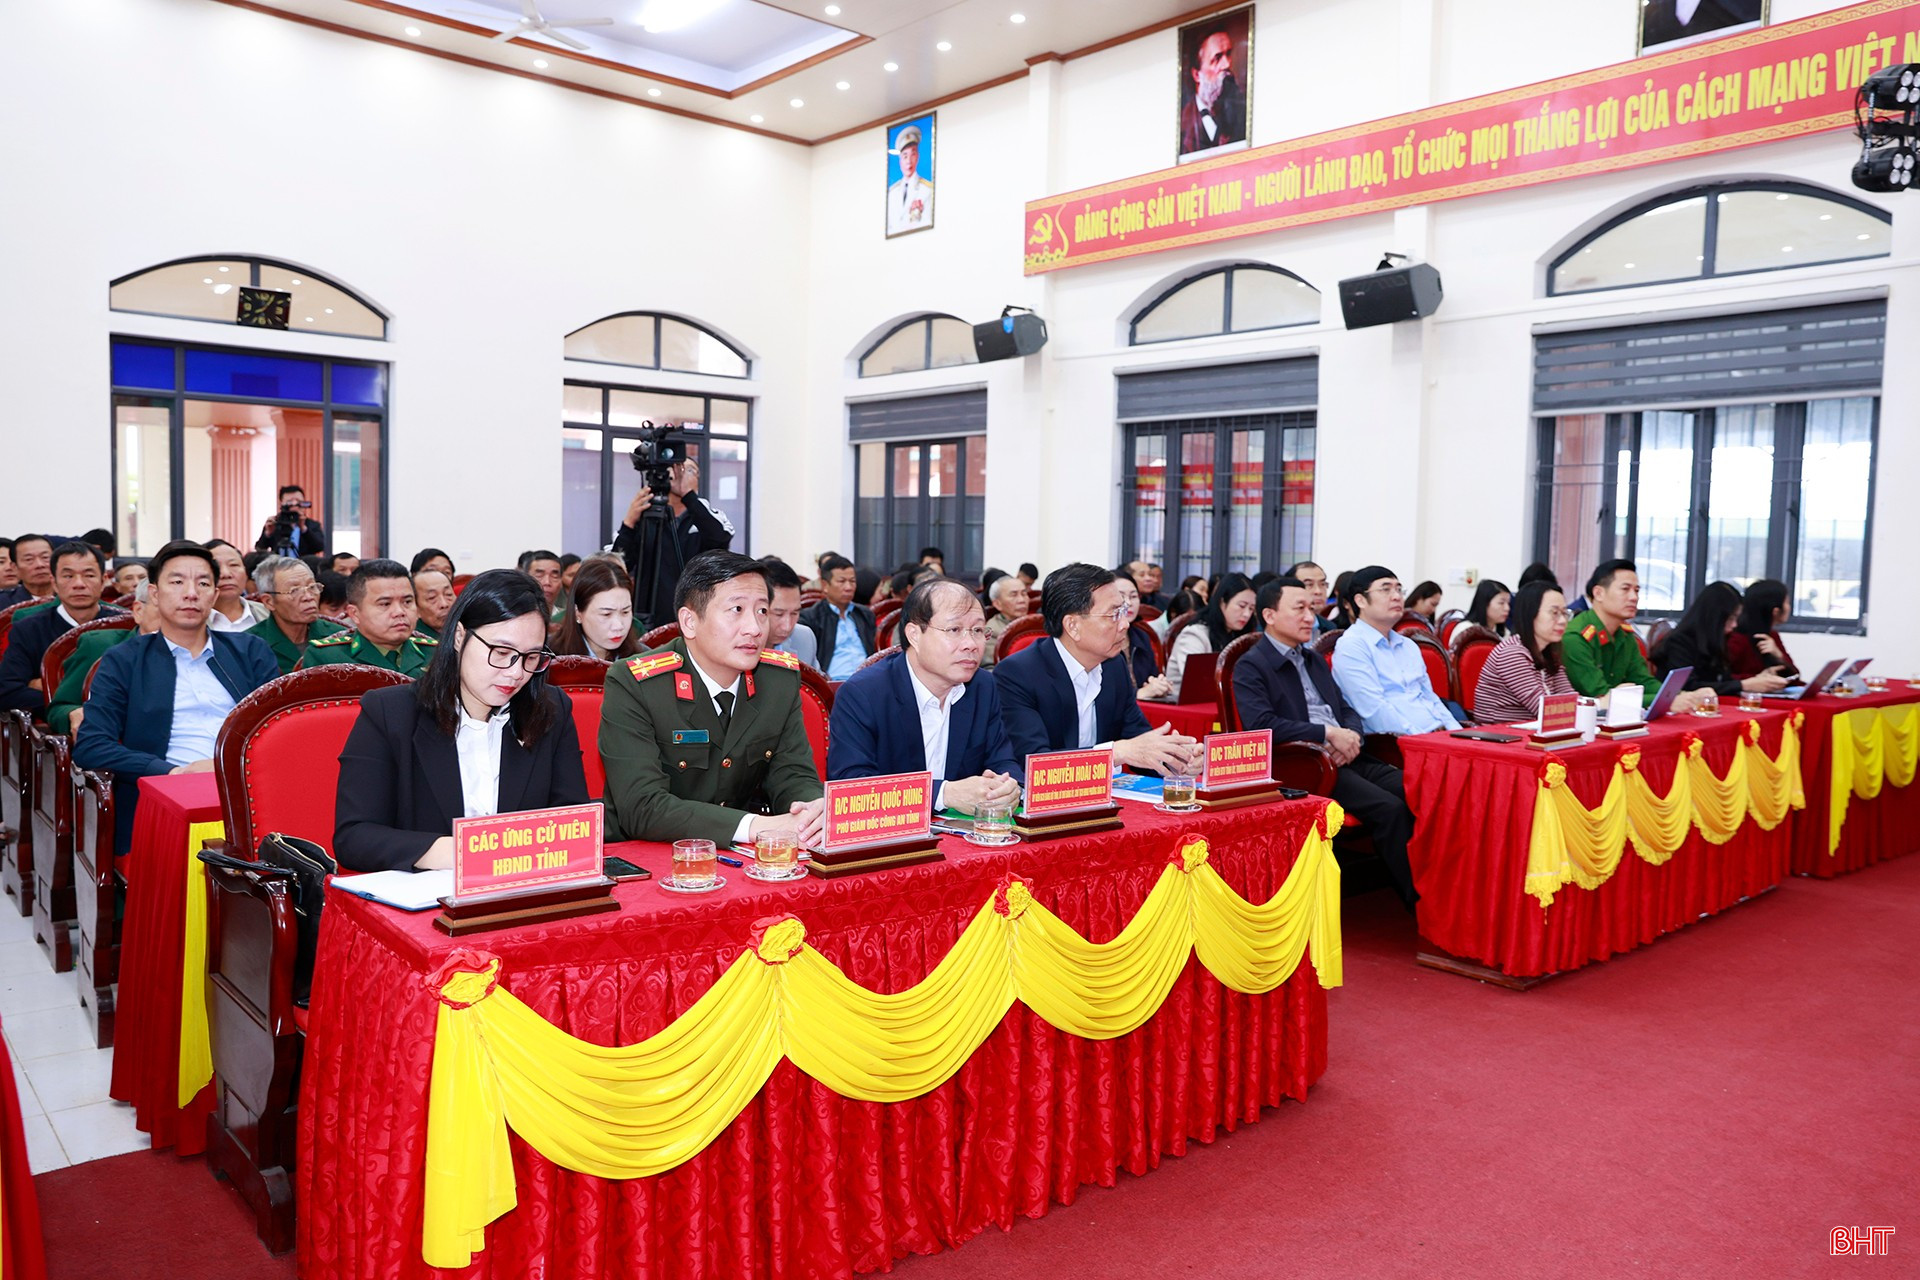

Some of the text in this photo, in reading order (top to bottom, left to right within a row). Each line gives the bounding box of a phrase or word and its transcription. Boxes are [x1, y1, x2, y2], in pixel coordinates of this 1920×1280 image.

[1074, 204, 1108, 243] ĐẢNG
[1110, 199, 1145, 240] CỘNG
[1146, 187, 1175, 229] SẢN
[1177, 183, 1206, 227] VIỆT
[1208, 180, 1242, 216] NAM
[1254, 161, 1301, 207] NGƯỜI
[1304, 157, 1347, 197] LÃNH
[1350, 150, 1388, 193] ĐẠO,
[1392, 129, 1416, 180] TỔ
[1418, 128, 1466, 175] CHỨC
[1471, 123, 1509, 169] MỌI
[1513, 100, 1580, 157] THẮNG
[1584, 96, 1620, 149] LỢI
[1624, 78, 1670, 136] CỦA
[1676, 71, 1742, 125] CÁCH
[1747, 53, 1828, 114] MẠNG
[1047, 761, 1075, 785] NGUYỄN
[1092, 761, 1107, 779] SƠN
[849, 787, 880, 814] NGUYỄN
[881, 784, 902, 811] QUỐC
[902, 785, 923, 806] HÙNG
[468, 819, 590, 853] CÁC ỨNG CỬ VIÊN
[836, 819, 849, 834] PHÓ
[850, 818, 866, 832] GIÁM
[897, 813, 905, 825] AN
[492, 847, 568, 877] HĐND TỈNH
